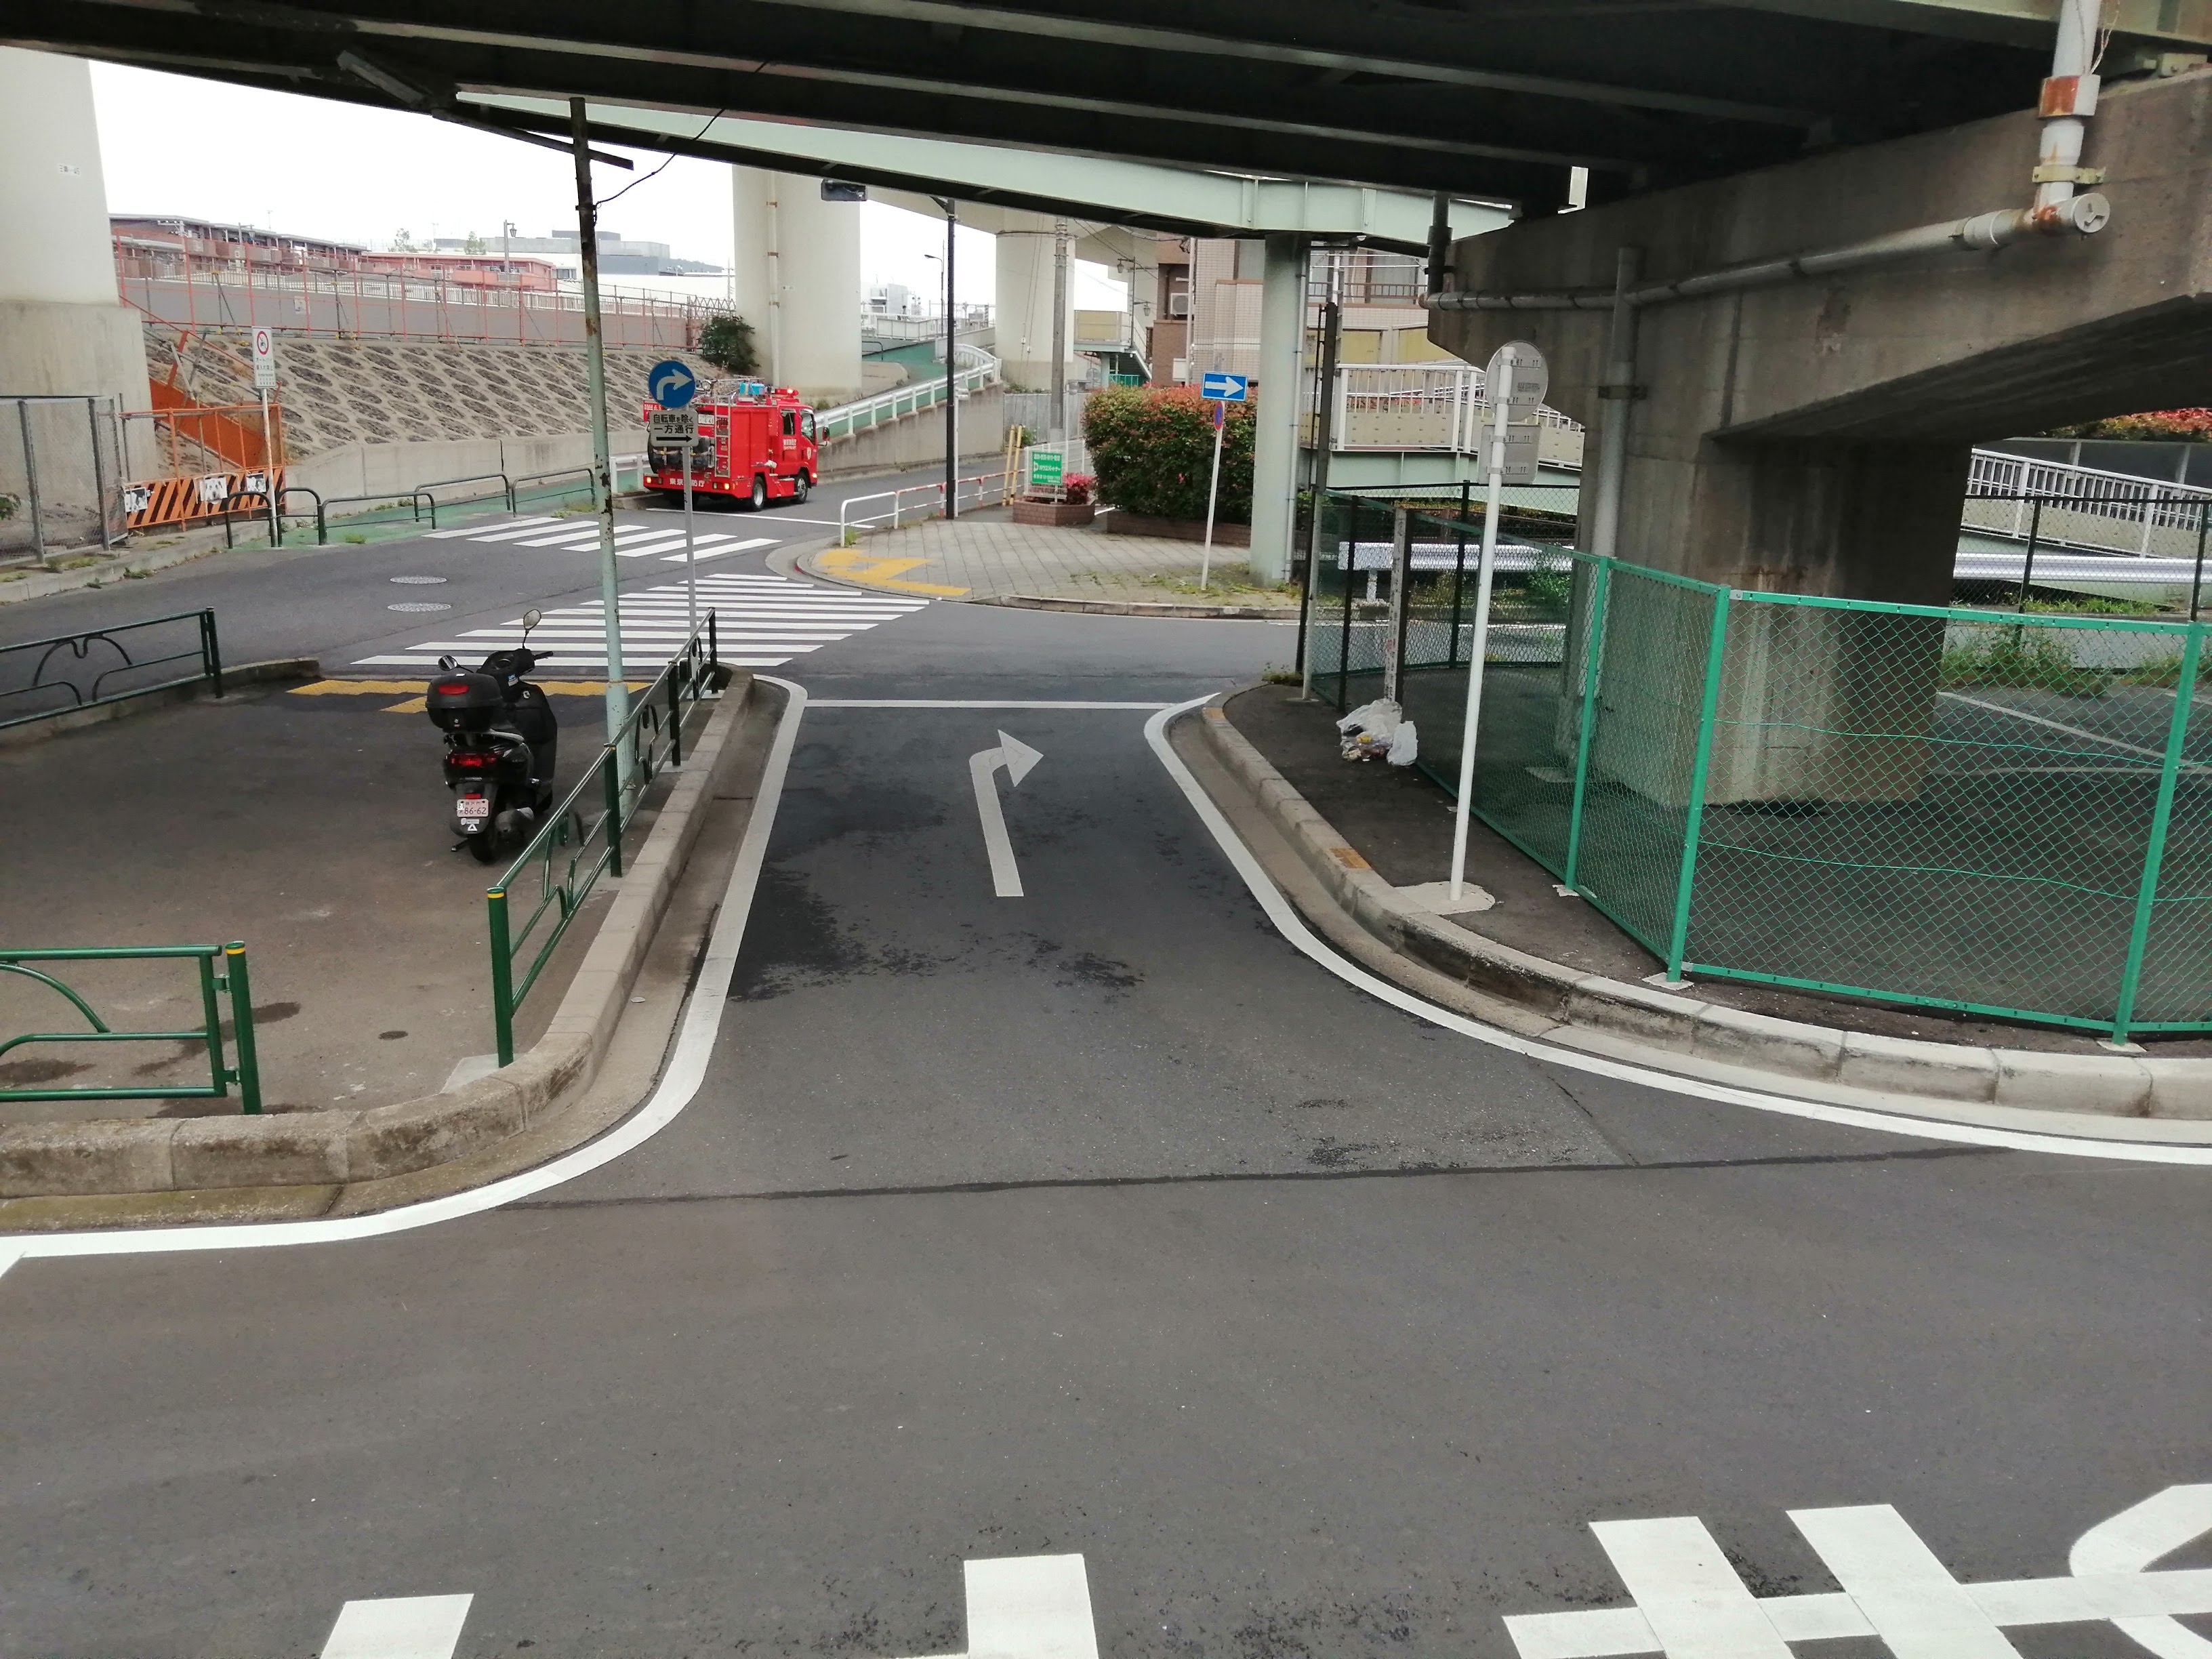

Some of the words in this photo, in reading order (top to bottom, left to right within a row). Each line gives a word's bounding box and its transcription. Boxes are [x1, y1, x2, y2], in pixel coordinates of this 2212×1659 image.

[653, 414, 693, 424] 自転車を除く
[654, 424, 694, 434] 一方通行
[670, 478, 705, 487] 東京防庁
